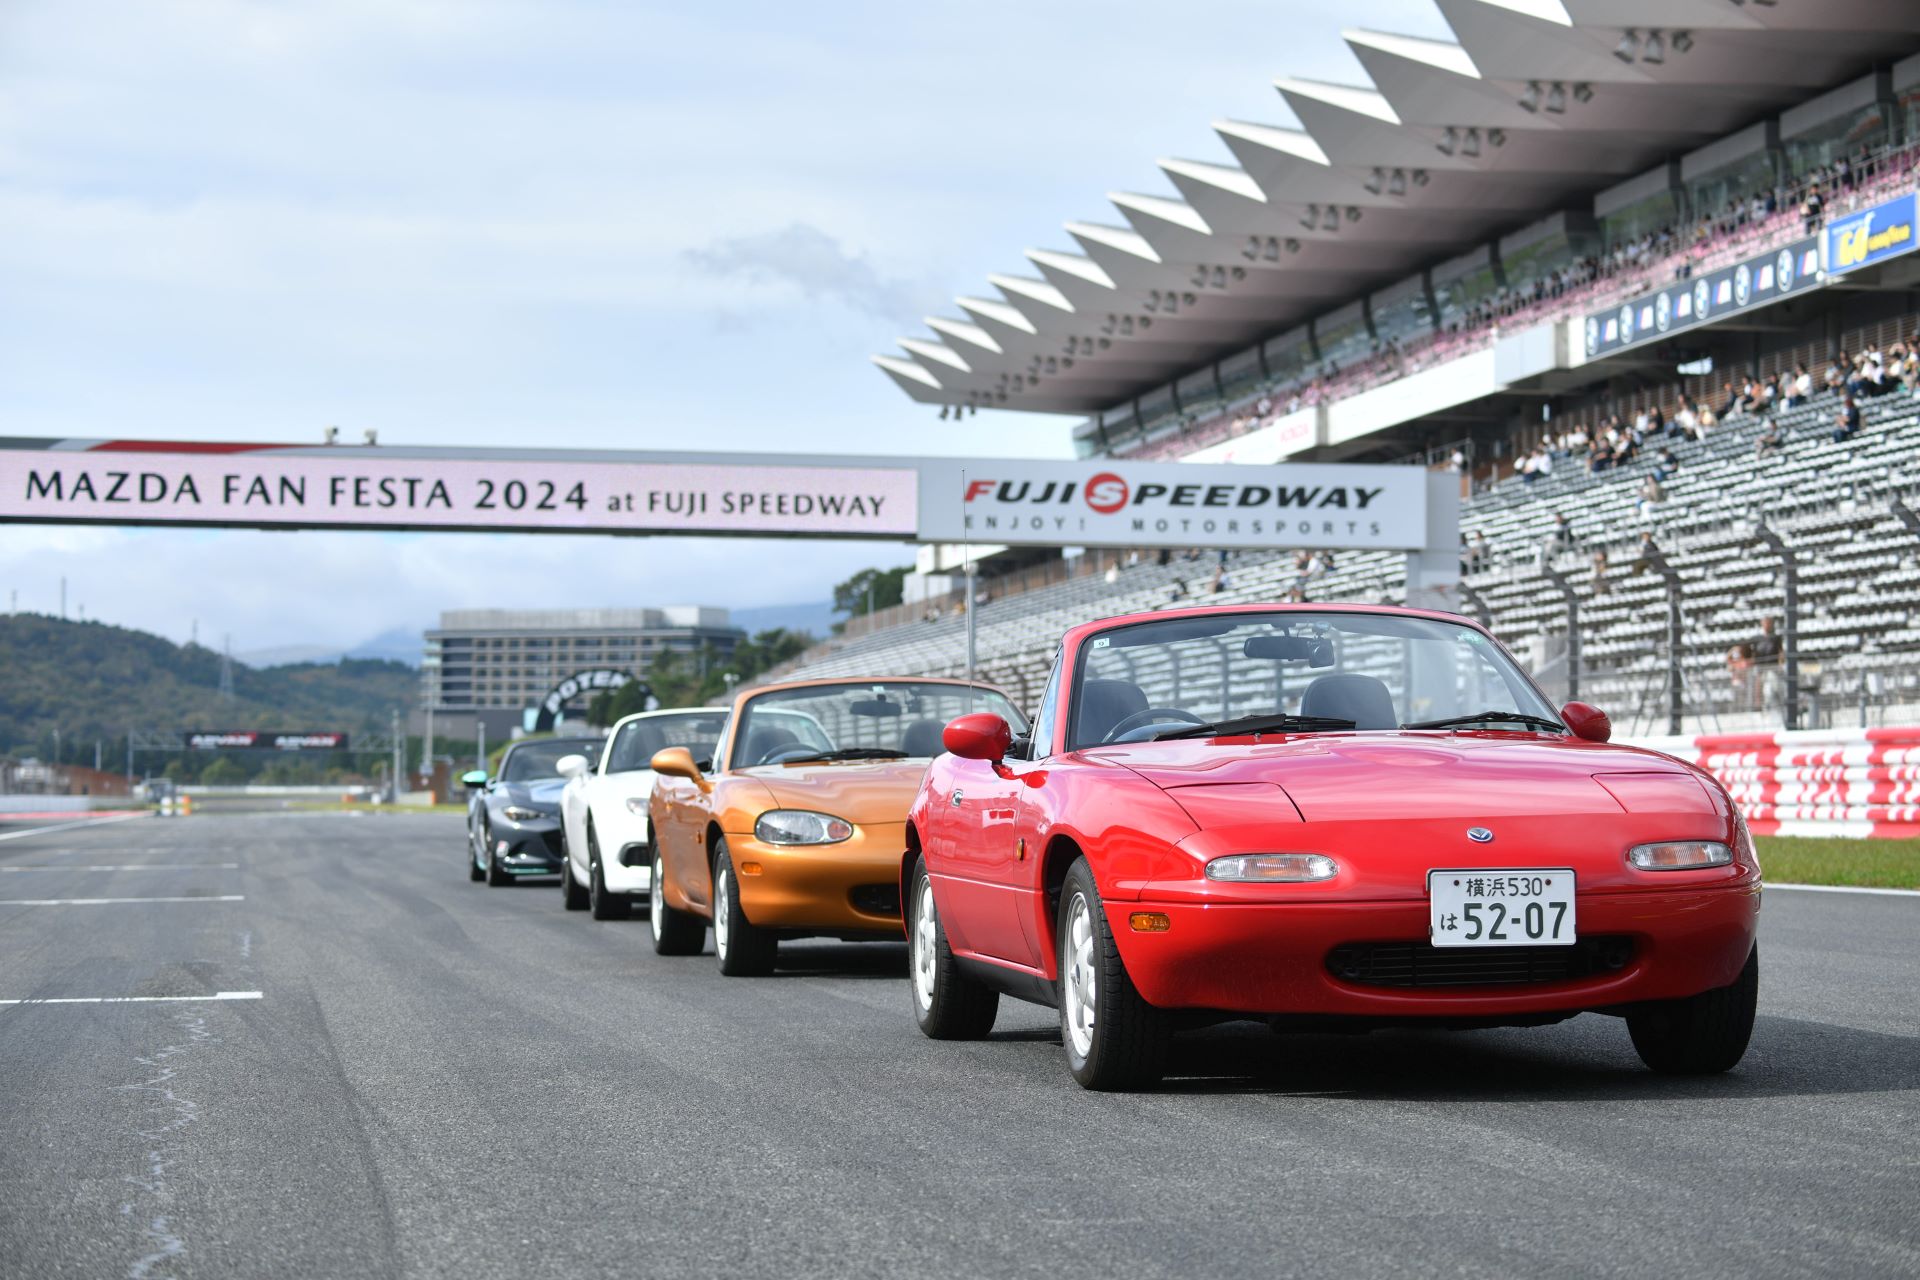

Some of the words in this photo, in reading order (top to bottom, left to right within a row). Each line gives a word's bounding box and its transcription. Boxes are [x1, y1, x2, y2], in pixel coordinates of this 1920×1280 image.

[26, 471, 201, 503] MAZDA
[223, 475, 305, 506] FAN
[330, 477, 453, 509] FESTA
[474, 479, 589, 511] 2024
[607, 494, 634, 512] at
[648, 491, 707, 517] FUJI
[721, 493, 885, 518] SPEEDWAY
[964, 479, 1078, 505] FUJI
[1086, 474, 1384, 512] SPEEDWAY
[964, 516, 1085, 532] ENJOY!
[1131, 518, 1381, 537] MOTORSPORTS
[545, 670, 660, 714] POTEN
[1440, 913, 1458, 931] は
[1463, 902, 1568, 940] 52-07
